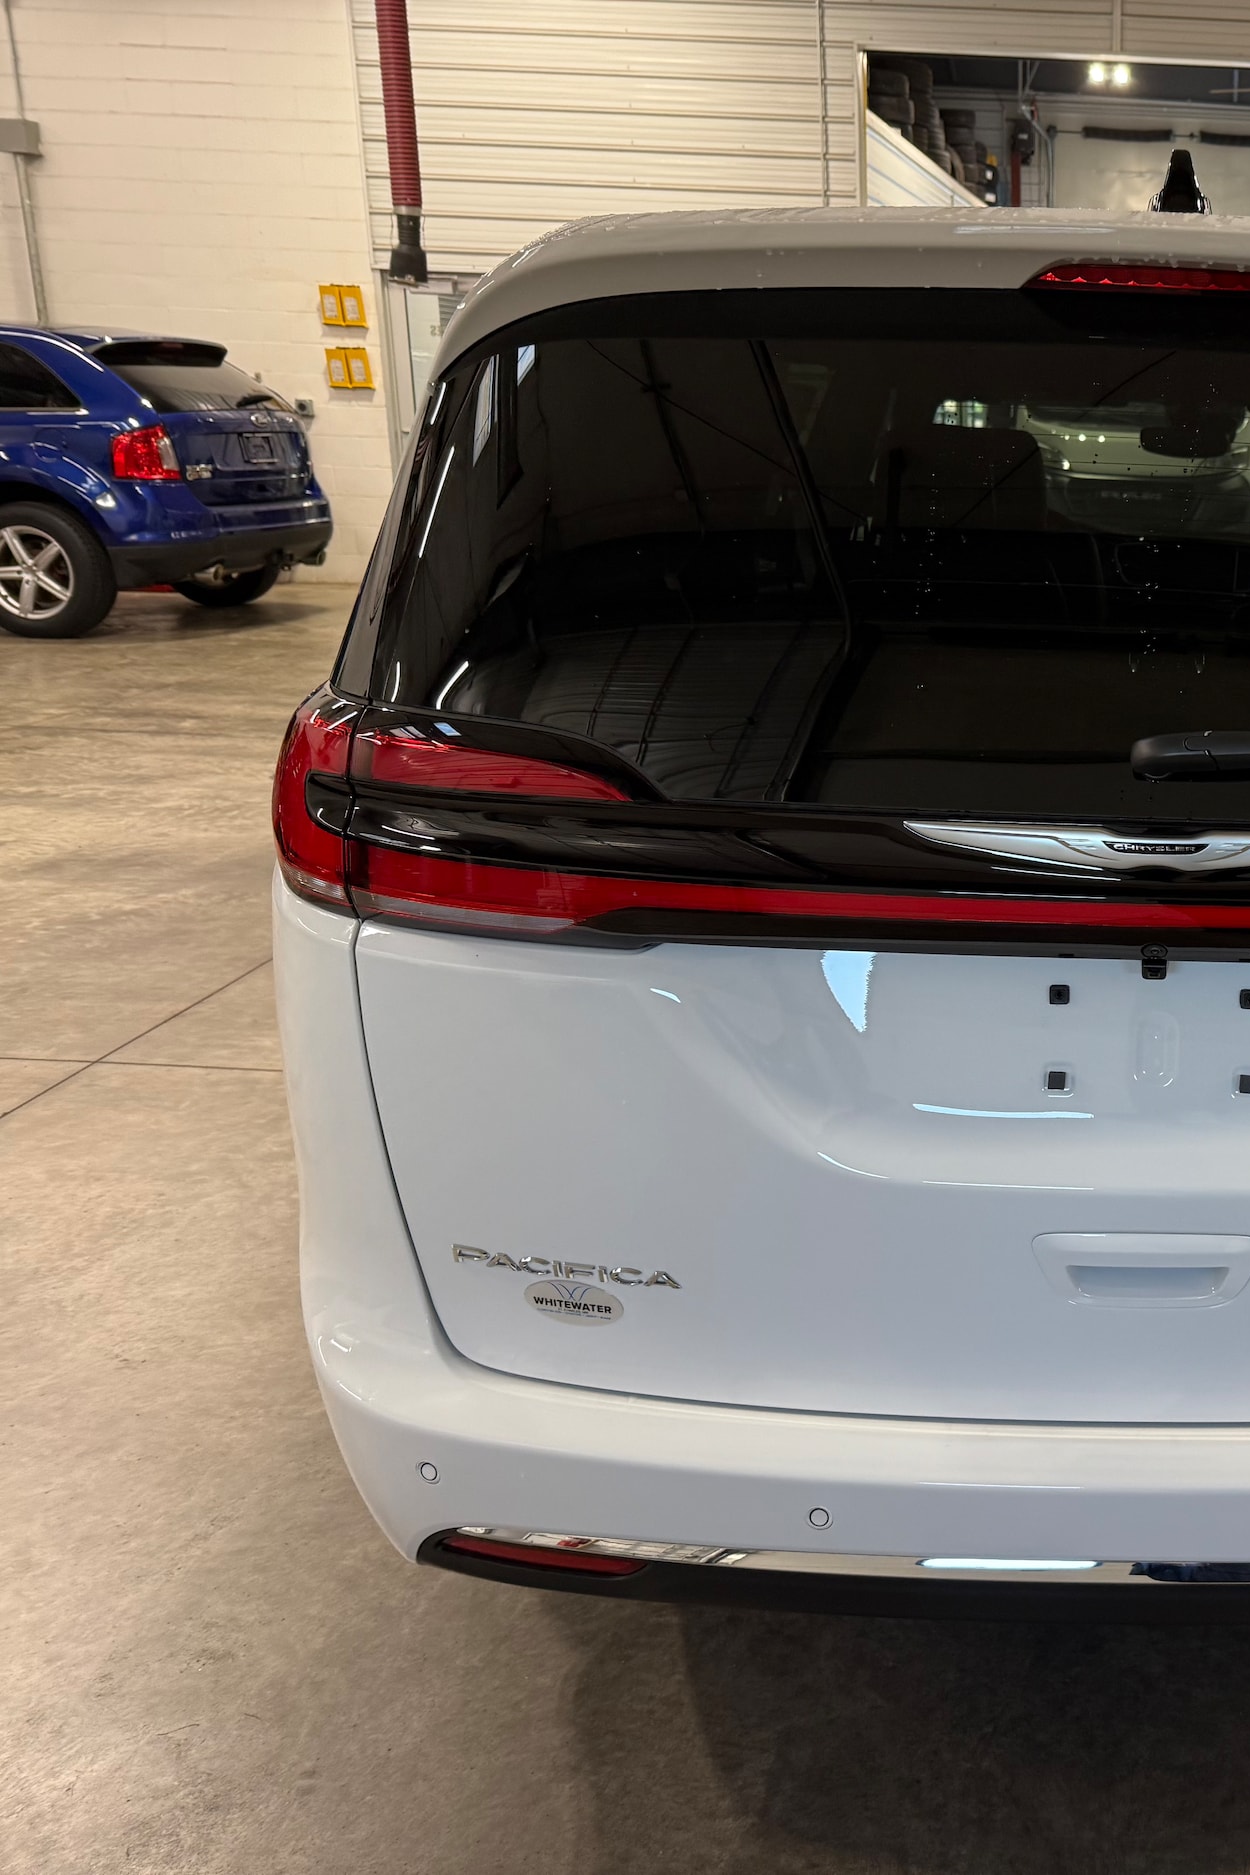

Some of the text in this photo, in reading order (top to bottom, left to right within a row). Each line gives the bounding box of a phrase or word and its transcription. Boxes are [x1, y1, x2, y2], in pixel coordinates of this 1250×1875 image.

[1113, 843, 1195, 852] CHRYSLER
[451, 1243, 682, 1289] PACIFICA
[533, 1296, 612, 1314] WHITEWATER
